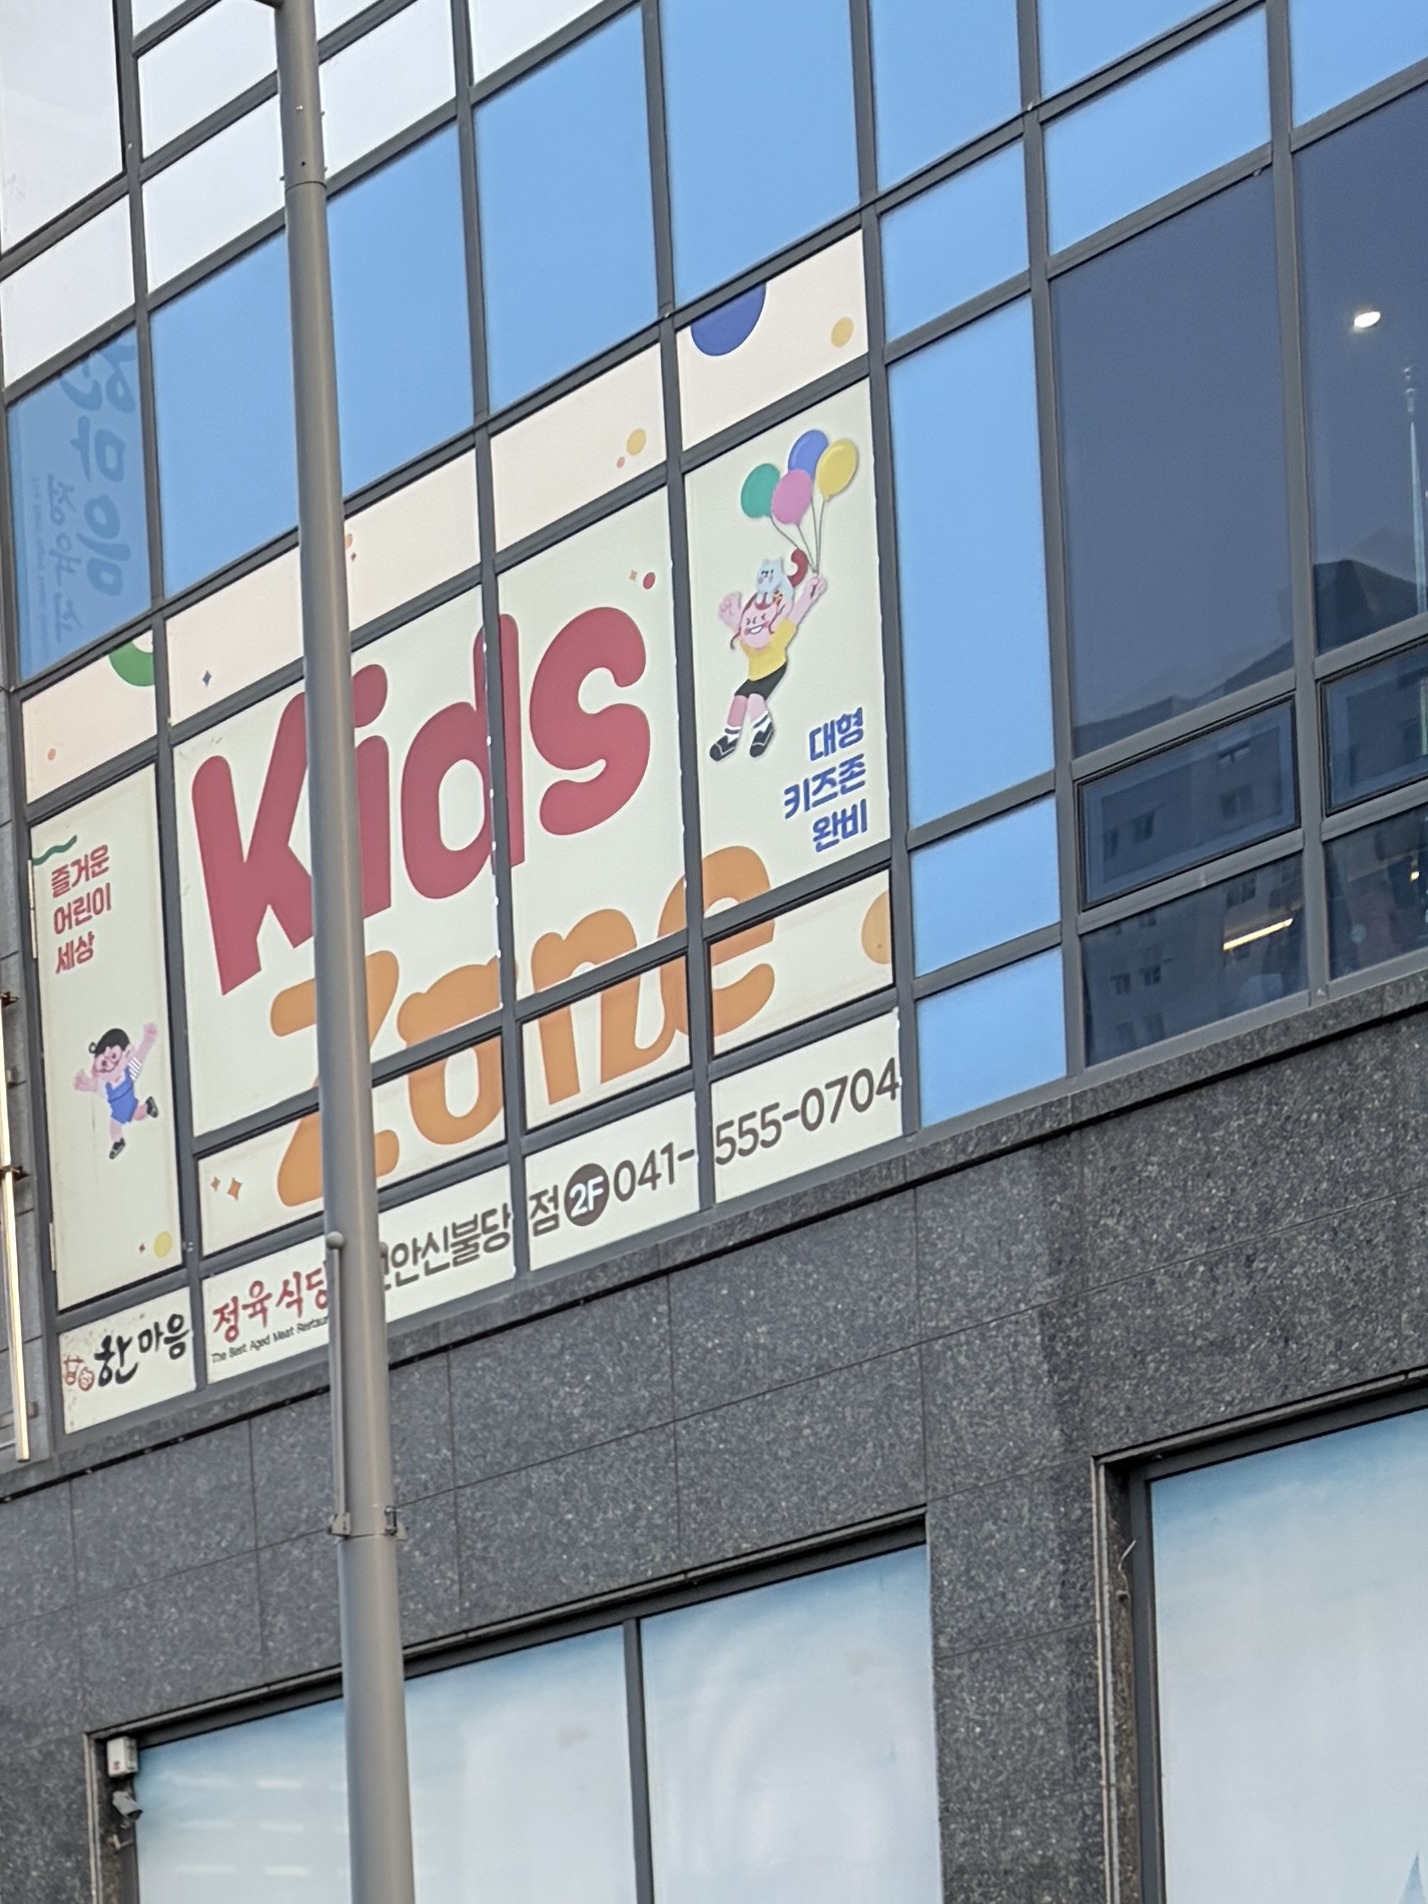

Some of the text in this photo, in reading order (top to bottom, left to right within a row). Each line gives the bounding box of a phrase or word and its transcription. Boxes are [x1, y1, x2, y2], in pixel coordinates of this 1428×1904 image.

[808, 706, 865, 763] 대형
[191, 606, 651, 996] Kids
[783, 755, 867, 820] 키즈존
[811, 798, 868, 853] 완비
[50, 844, 111, 898] 즐거운
[52, 884, 114, 934] 어린이
[55, 930, 96, 975] 세상
[383, 1184, 560, 1291] 안신불당점
[569, 1175, 604, 1216] 2F
[94, 1314, 190, 1388] 한마음
